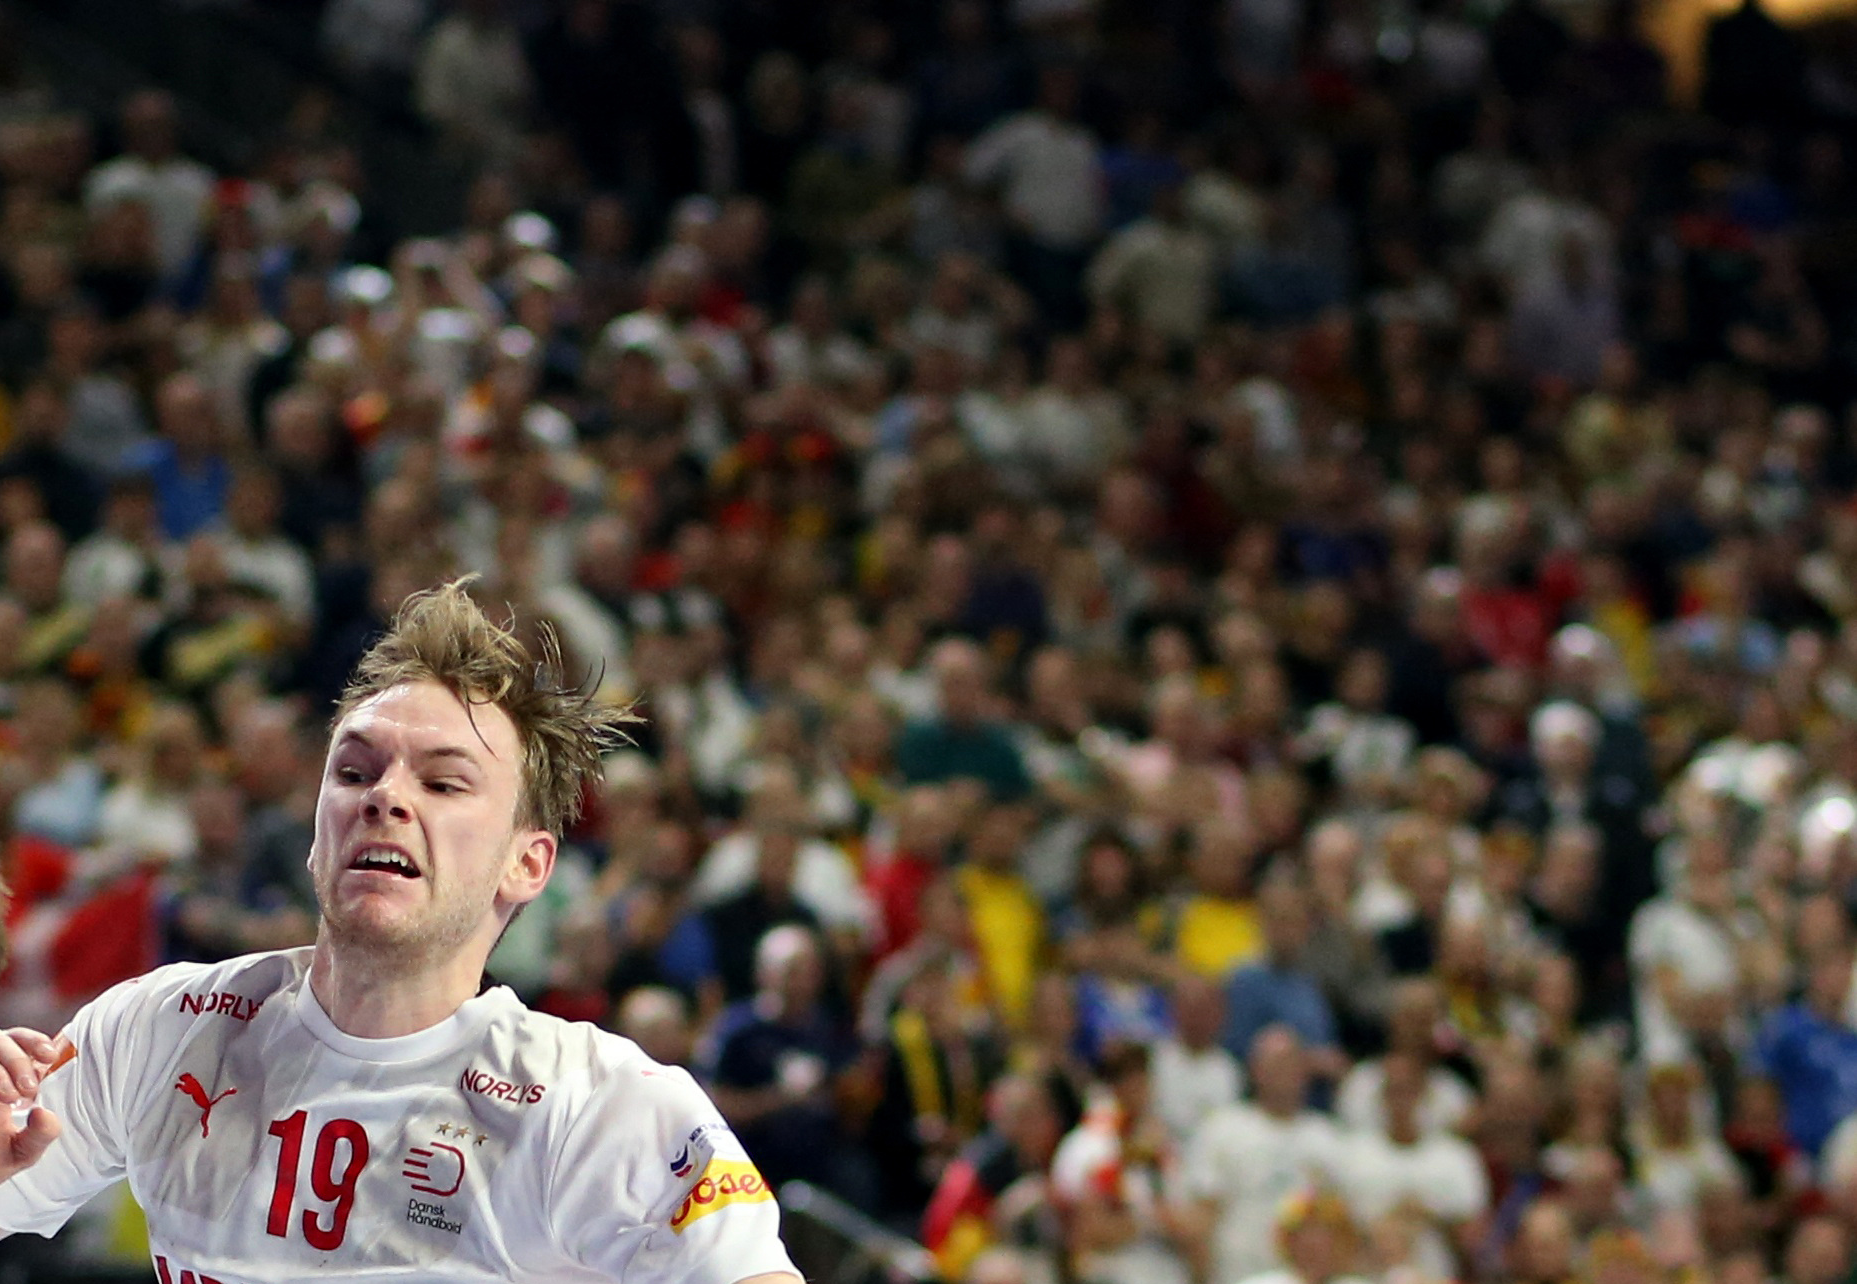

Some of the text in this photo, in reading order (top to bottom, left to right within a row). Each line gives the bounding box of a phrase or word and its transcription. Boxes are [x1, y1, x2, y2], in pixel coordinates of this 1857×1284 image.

[179, 992, 264, 1022] NORLY
[460, 1067, 546, 1104] NORLYS
[267, 1109, 370, 1251] 19
[408, 1199, 446, 1217] Dansk
